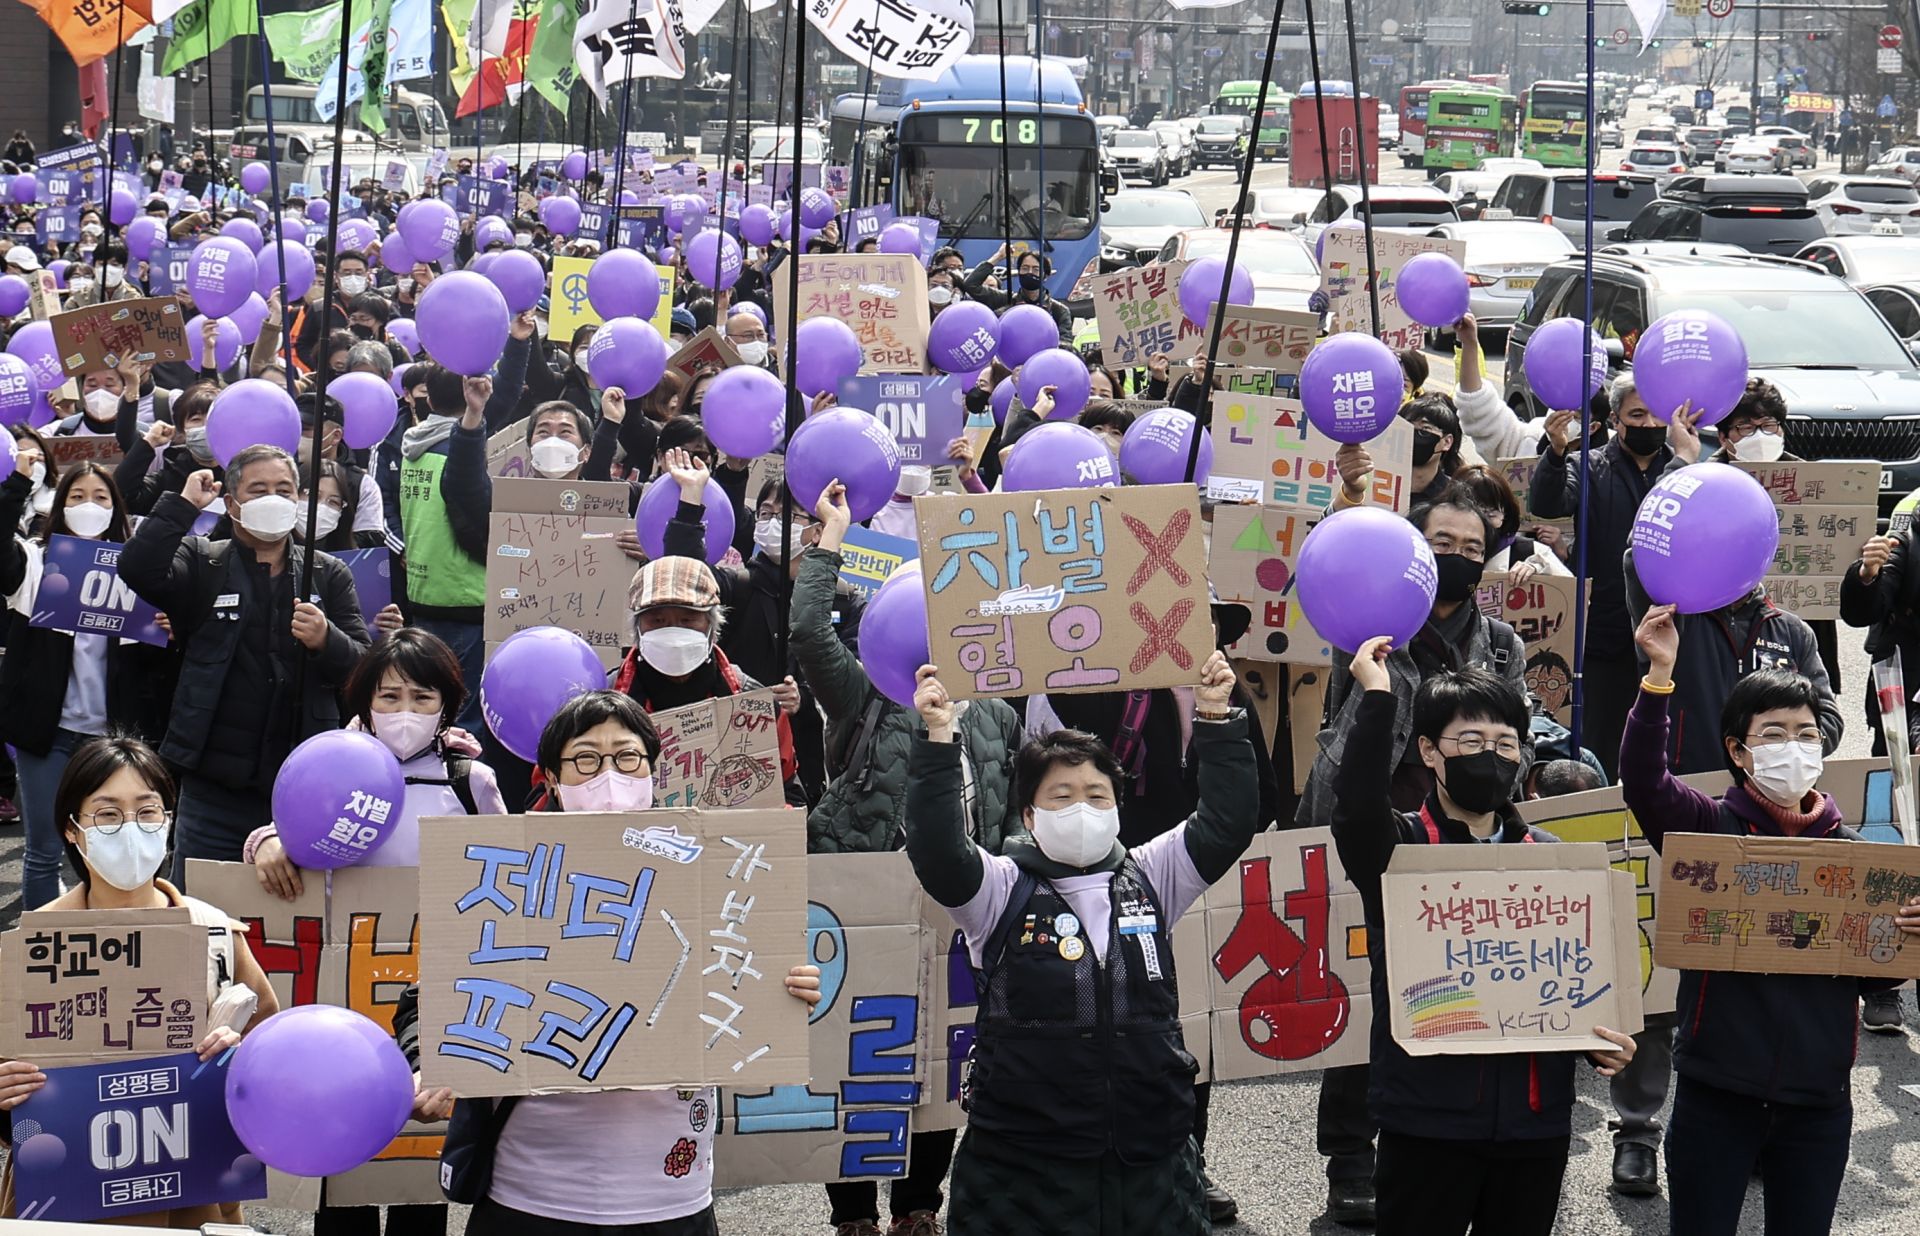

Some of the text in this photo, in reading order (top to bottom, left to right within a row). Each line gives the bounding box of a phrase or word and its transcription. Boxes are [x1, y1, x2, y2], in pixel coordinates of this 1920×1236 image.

[1712, 0, 1728, 12] 50
[1472, 107, 1489, 116] 1711
[961, 118, 1037, 144] 708
[49, 180, 70, 195] ON
[468, 189, 491, 206] ON
[46, 216, 65, 232] NO
[579, 213, 602, 231] NO
[857, 217, 879, 235] NO
[201, 247, 231, 262] 차별
[198, 261, 226, 280] 혐오
[1103, 267, 1168, 301] 차별
[806, 292, 853, 317] 차별
[973, 326, 996, 352] 차별
[1113, 321, 1177, 363] 성평등
[1217, 319, 1311, 359] 성평등
[1663, 321, 1708, 344] 혐오
[960, 338, 986, 363] 혐오
[1332, 371, 1375, 394] 차별
[875, 402, 926, 438] ON
[1333, 395, 1376, 420] 혐오
[1076, 455, 1113, 483] 차별
[1271, 456, 1338, 508] 일할
[1655, 472, 1704, 499] 차별
[1638, 494, 1681, 530] 혐오
[930, 500, 1108, 594] 차별
[80, 569, 137, 613] ON
[979, 603, 1047, 615] 공공운수노조
[950, 604, 1121, 693] 혐오
[732, 713, 775, 733] OUT
[343, 790, 392, 825] 차별
[328, 817, 379, 850] 혐오
[623, 836, 681, 861] 공공운수노조
[1733, 860, 1808, 896] 장애인,
[455, 842, 658, 965] 젠더
[1682, 908, 1755, 946] 모두가
[1766, 908, 1830, 950] 평등한
[25, 930, 142, 984] 학교에
[1538, 977, 1612, 1009] 으로
[24, 985, 195, 1051] 페미니즘을
[437, 977, 639, 1082] 프리
[1497, 1009, 1571, 1037] KCTU
[106, 1074, 171, 1097] 성평등
[88, 1101, 190, 1171] ON
[109, 1174, 174, 1202] 차별은
